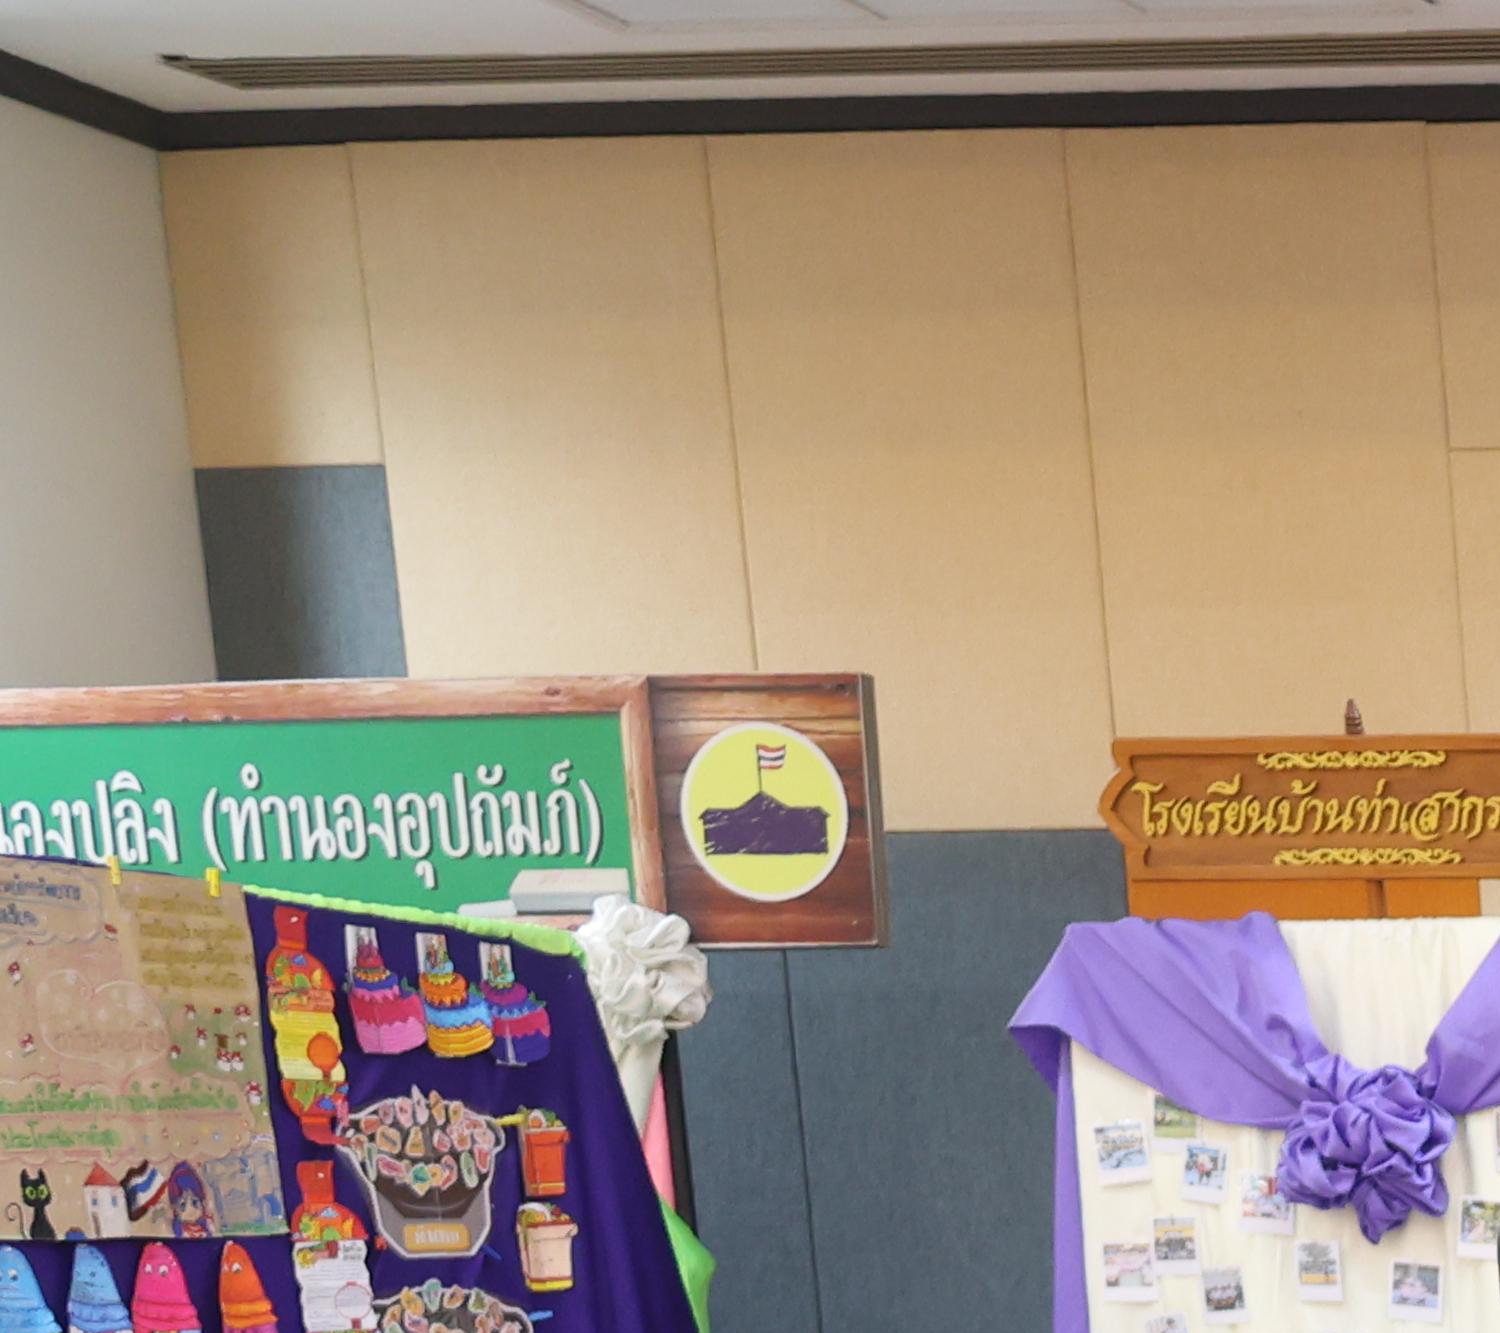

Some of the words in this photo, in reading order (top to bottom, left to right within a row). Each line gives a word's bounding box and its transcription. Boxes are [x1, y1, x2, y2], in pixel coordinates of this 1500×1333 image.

[202, 758, 604, 890] (ทำนองอุปถัมภ์)
